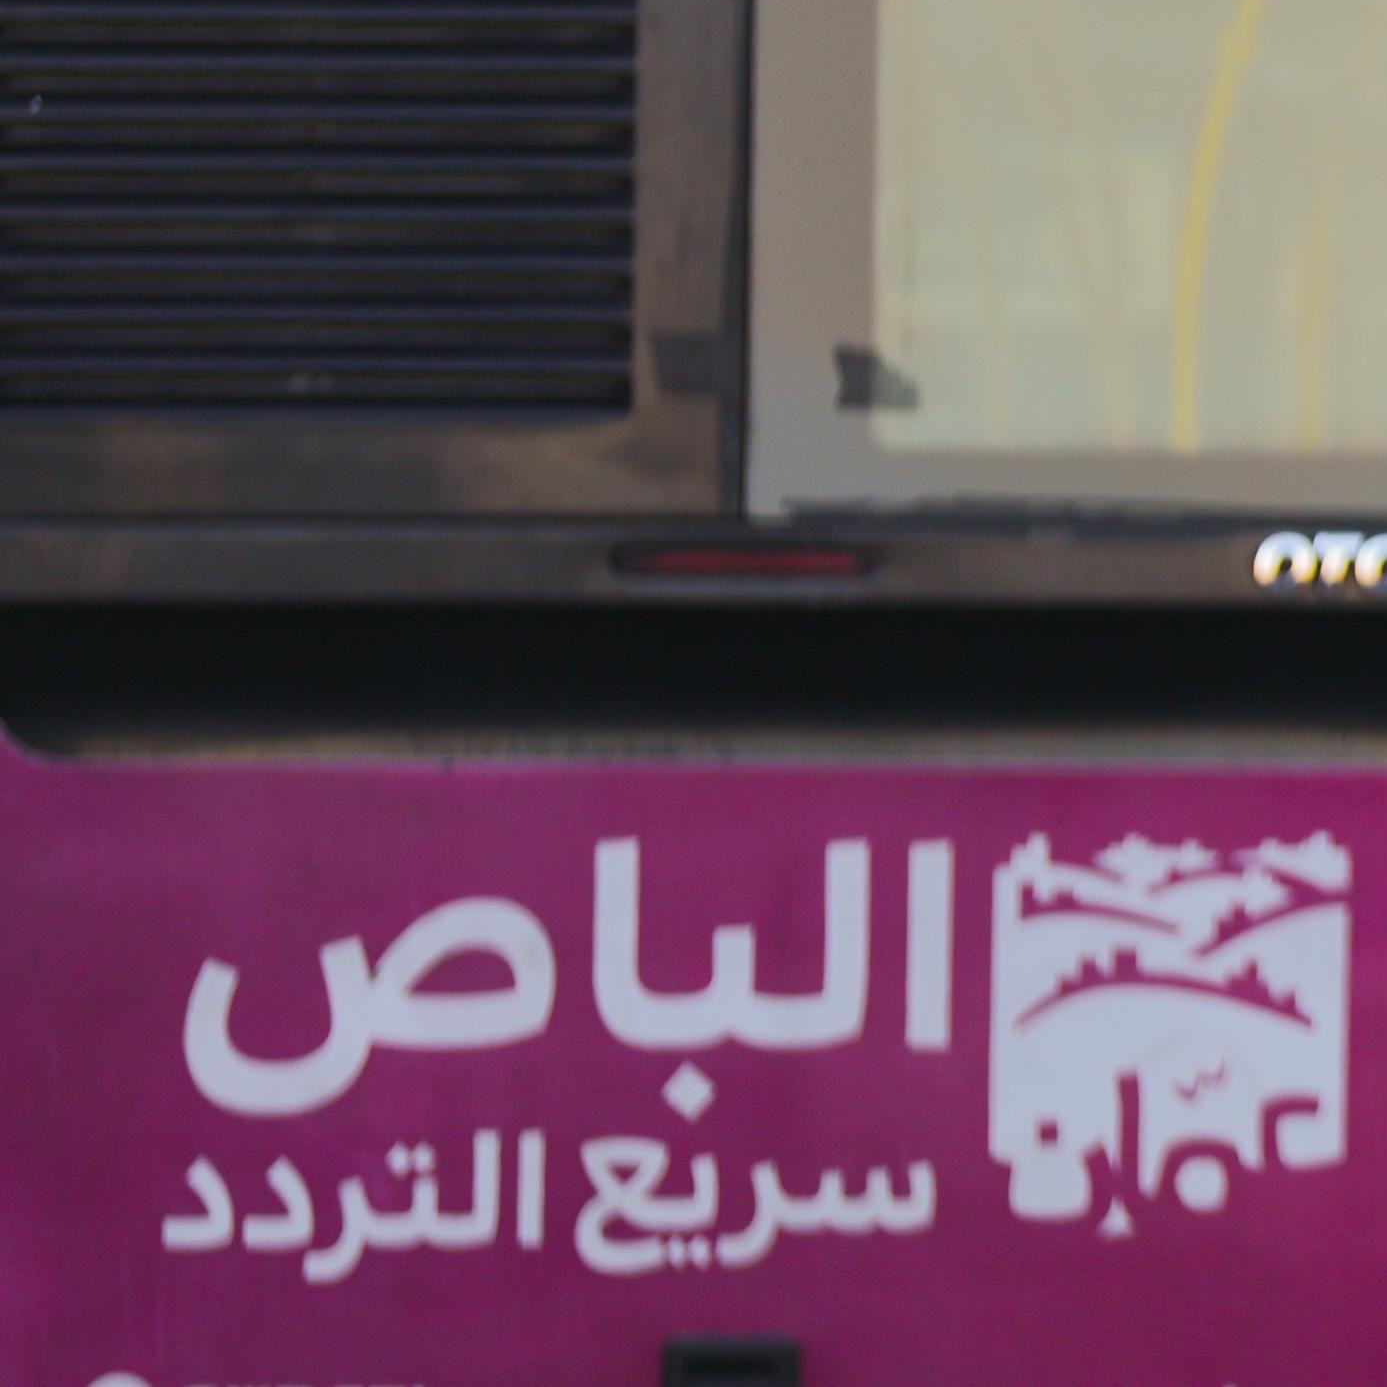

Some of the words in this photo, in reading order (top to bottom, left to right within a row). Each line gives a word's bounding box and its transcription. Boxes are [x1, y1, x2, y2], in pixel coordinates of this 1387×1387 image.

[183, 835, 953, 1122] الباص
[161, 1128, 545, 1284] التردد
[573, 1134, 937, 1276] سريع
